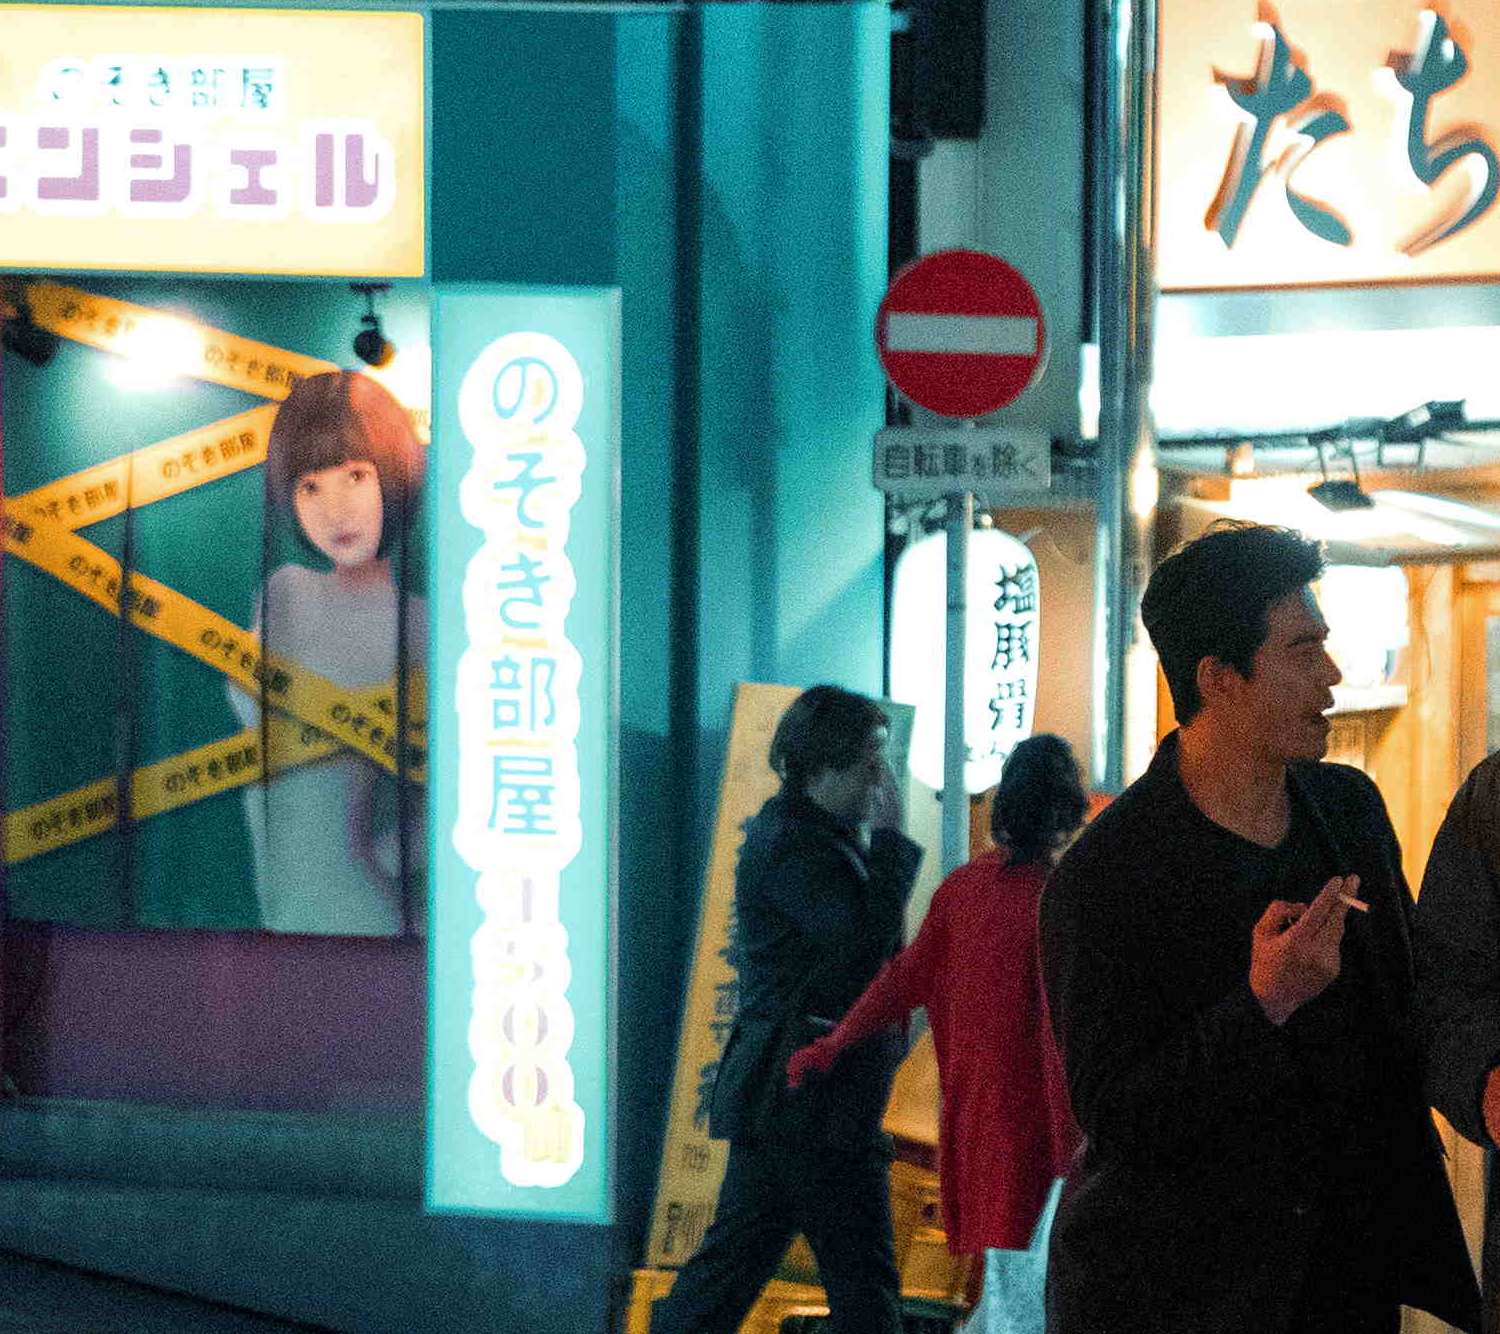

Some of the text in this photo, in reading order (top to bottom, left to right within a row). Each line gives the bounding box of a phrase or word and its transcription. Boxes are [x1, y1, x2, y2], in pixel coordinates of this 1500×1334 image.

[884, 442, 1038, 481] 自転車を除く
